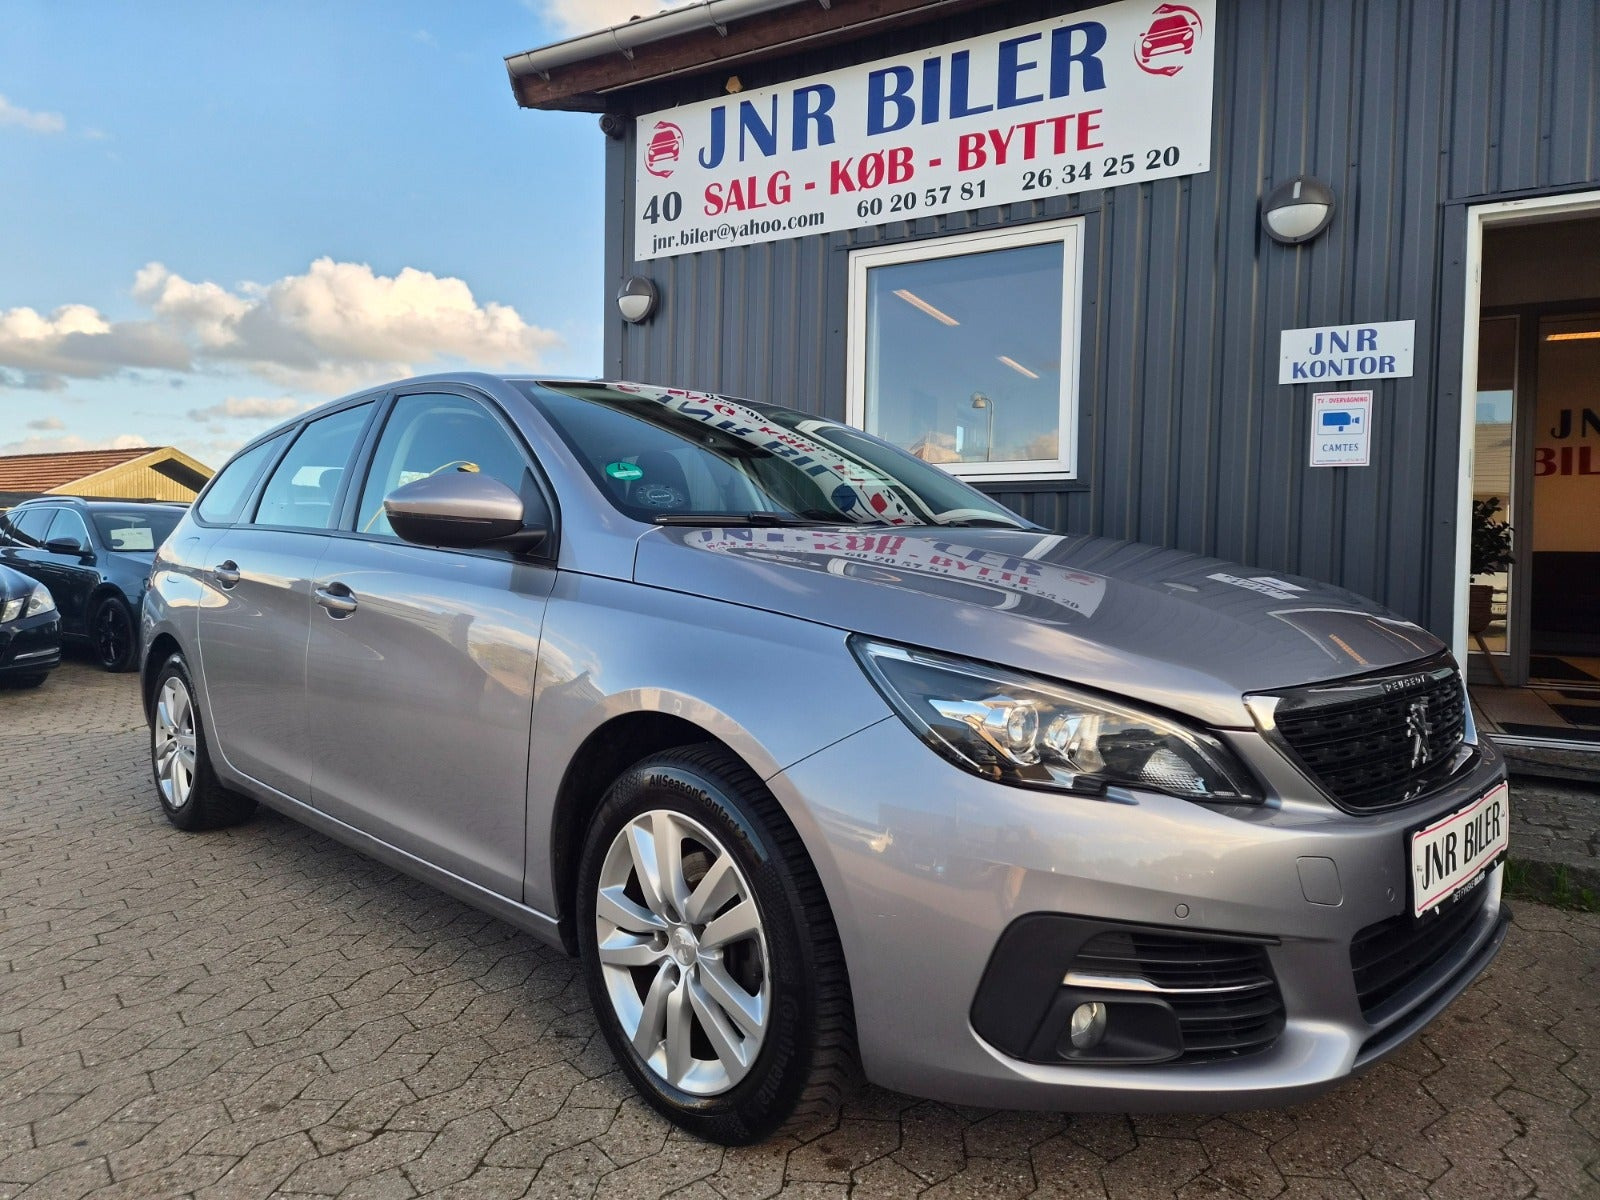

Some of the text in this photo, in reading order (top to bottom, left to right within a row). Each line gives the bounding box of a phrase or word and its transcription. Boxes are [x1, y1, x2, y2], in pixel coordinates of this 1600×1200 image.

[698, 20, 1107, 169] JNR BILER
[703, 108, 1103, 216] SALG - KØB - BYTTE
[1022, 146, 1180, 191] 26 34 25 20
[642, 191, 682, 225] 40
[857, 179, 986, 218] 60 20 57 81
[651, 211, 825, 254] jnr.biler@yahoo.com
[1308, 328, 1378, 356] JNR
[1292, 355, 1396, 380] KONTOR
[1322, 443, 1359, 452] CAMTES
[1421, 800, 1501, 891] JNR BILER
